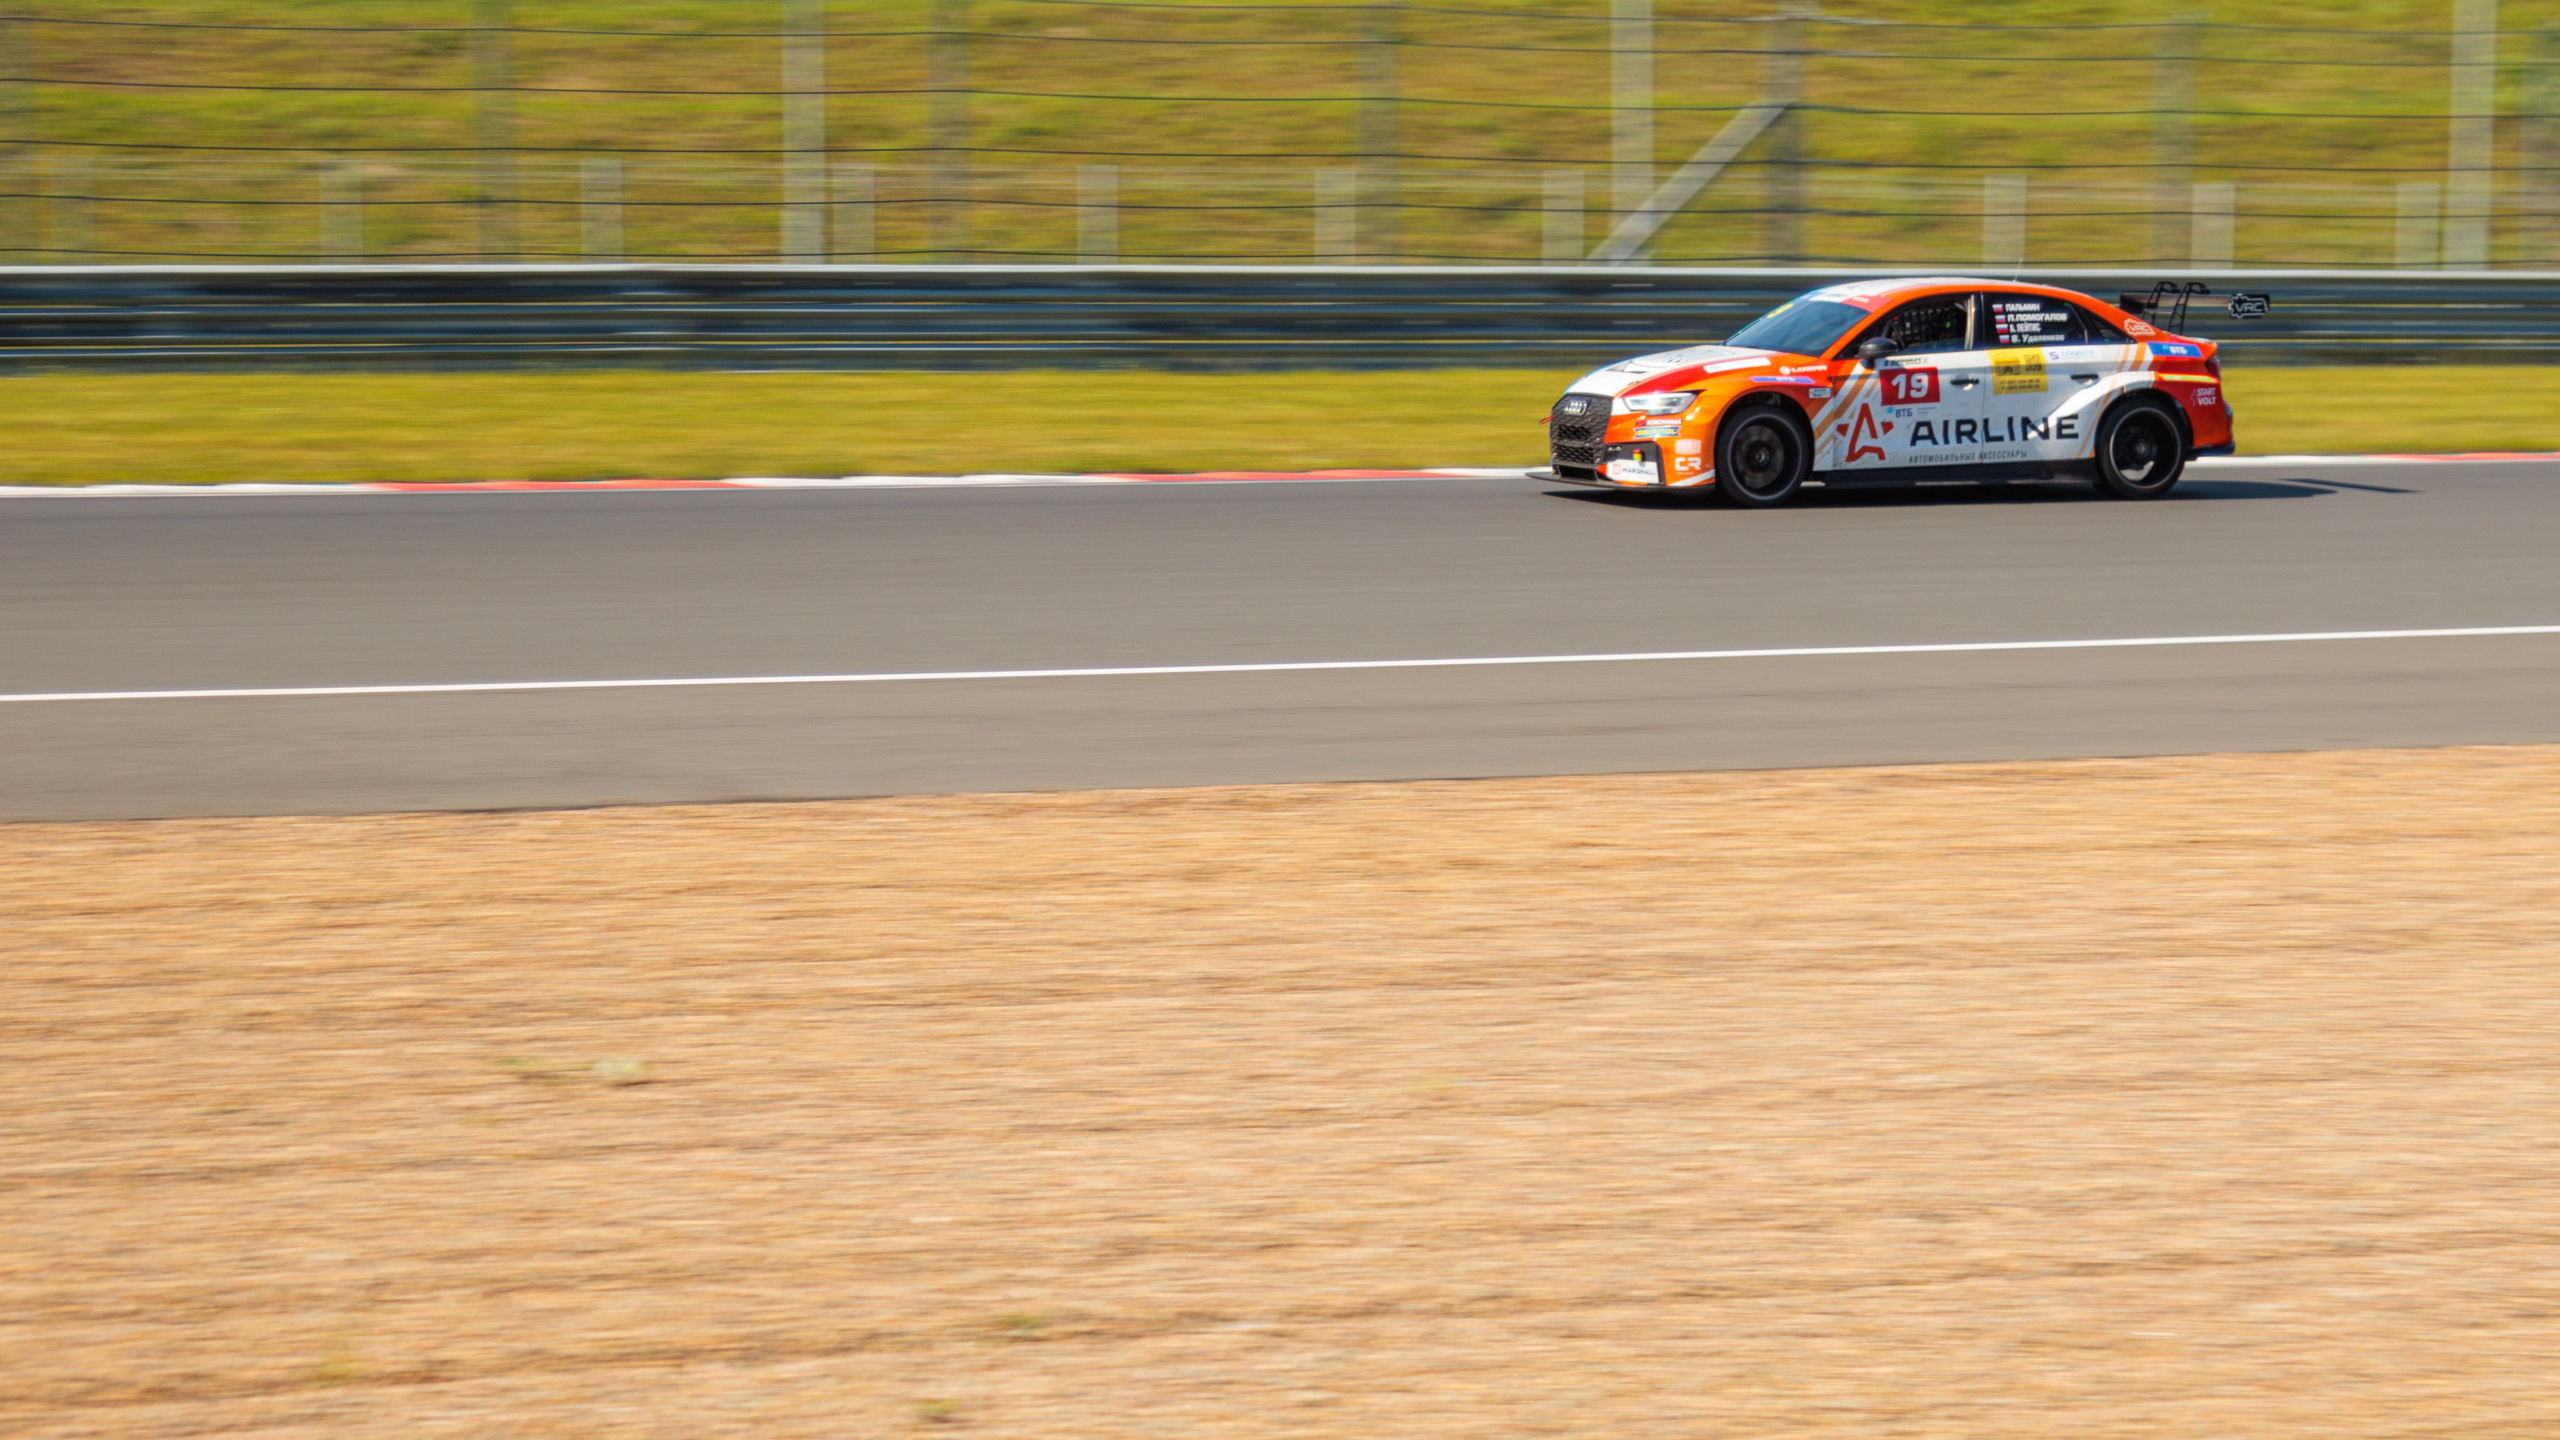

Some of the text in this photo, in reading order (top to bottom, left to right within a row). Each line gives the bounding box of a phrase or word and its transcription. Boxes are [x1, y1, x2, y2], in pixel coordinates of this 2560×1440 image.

[2235, 302, 2263, 312] VRC
[2169, 346, 2187, 355] ВТБ
[1891, 372, 1929, 399] 19
[2197, 388, 2216, 397] START
[2197, 397, 2216, 406] VOLT
[1895, 408, 1913, 418] ВТБ
[1910, 414, 2079, 447] AIRLINE
[1908, 450, 2028, 464] АВТОМОБИЛЬНЫЕ АКСЕССУАРЫ
[1622, 466, 1657, 476] MARSHALL
